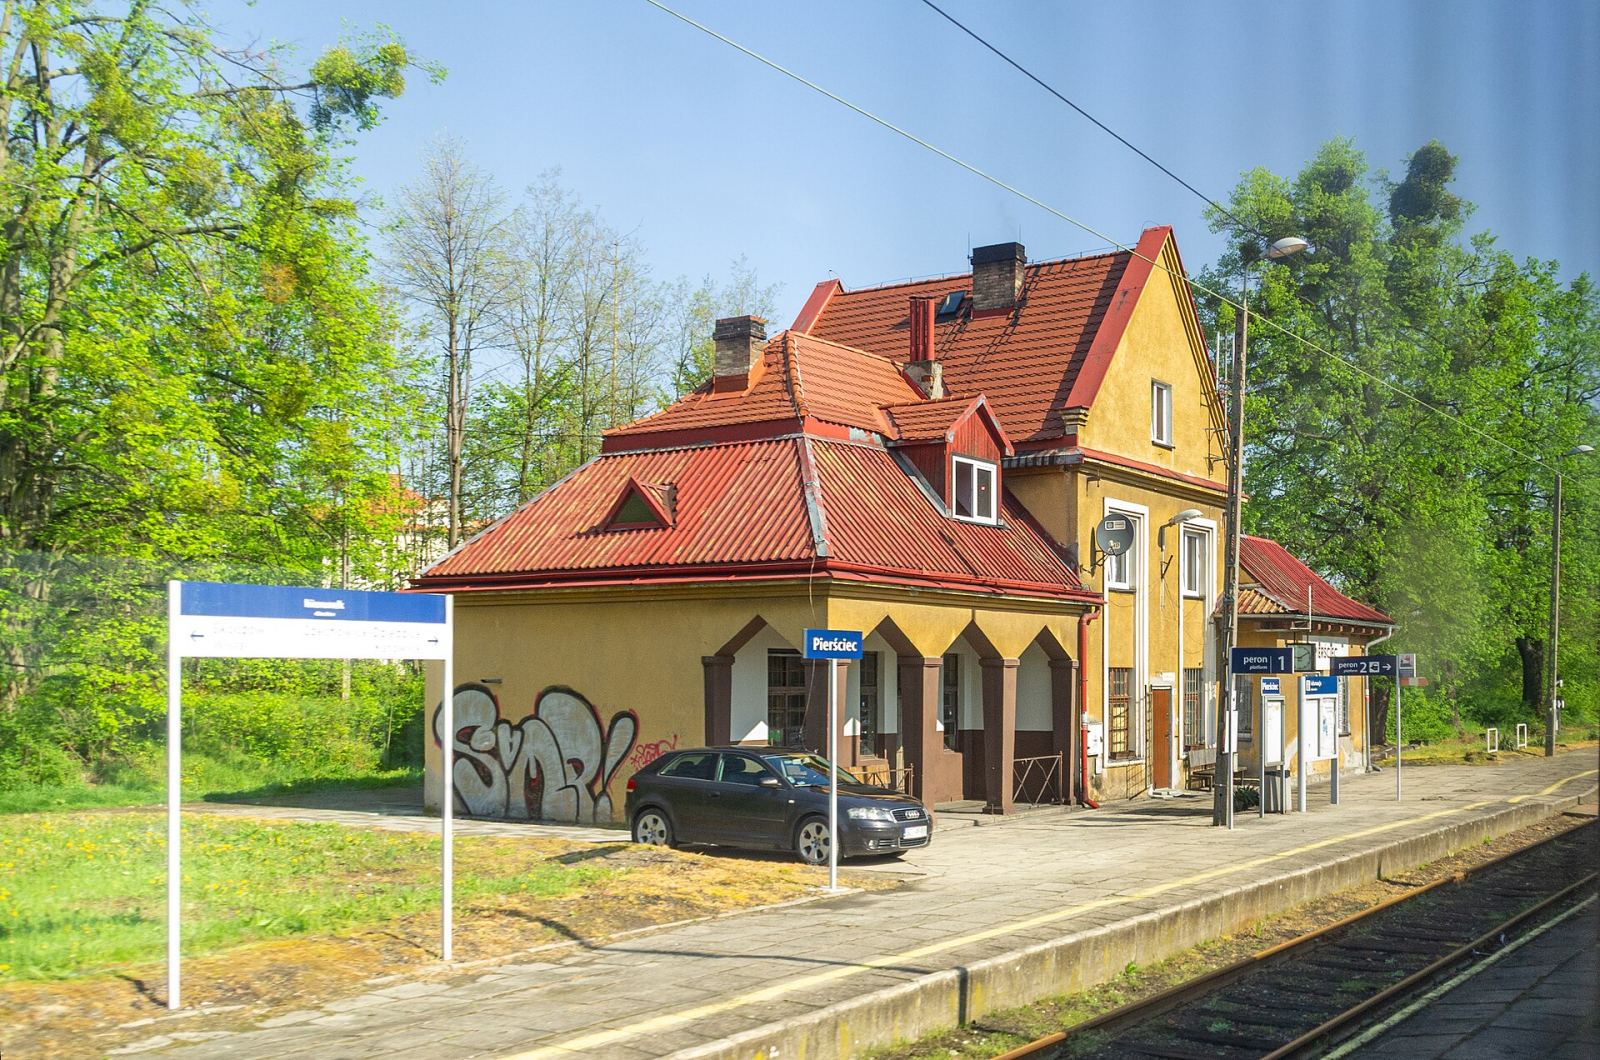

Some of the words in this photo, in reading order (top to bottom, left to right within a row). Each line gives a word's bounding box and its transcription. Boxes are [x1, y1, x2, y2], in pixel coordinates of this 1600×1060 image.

[812, 637, 858, 652] Pierściec
[1243, 656, 1268, 665] peron
[1278, 655, 1285, 671] 1
[1338, 661, 1358, 670] peron
[1359, 661, 1368, 673] 2
